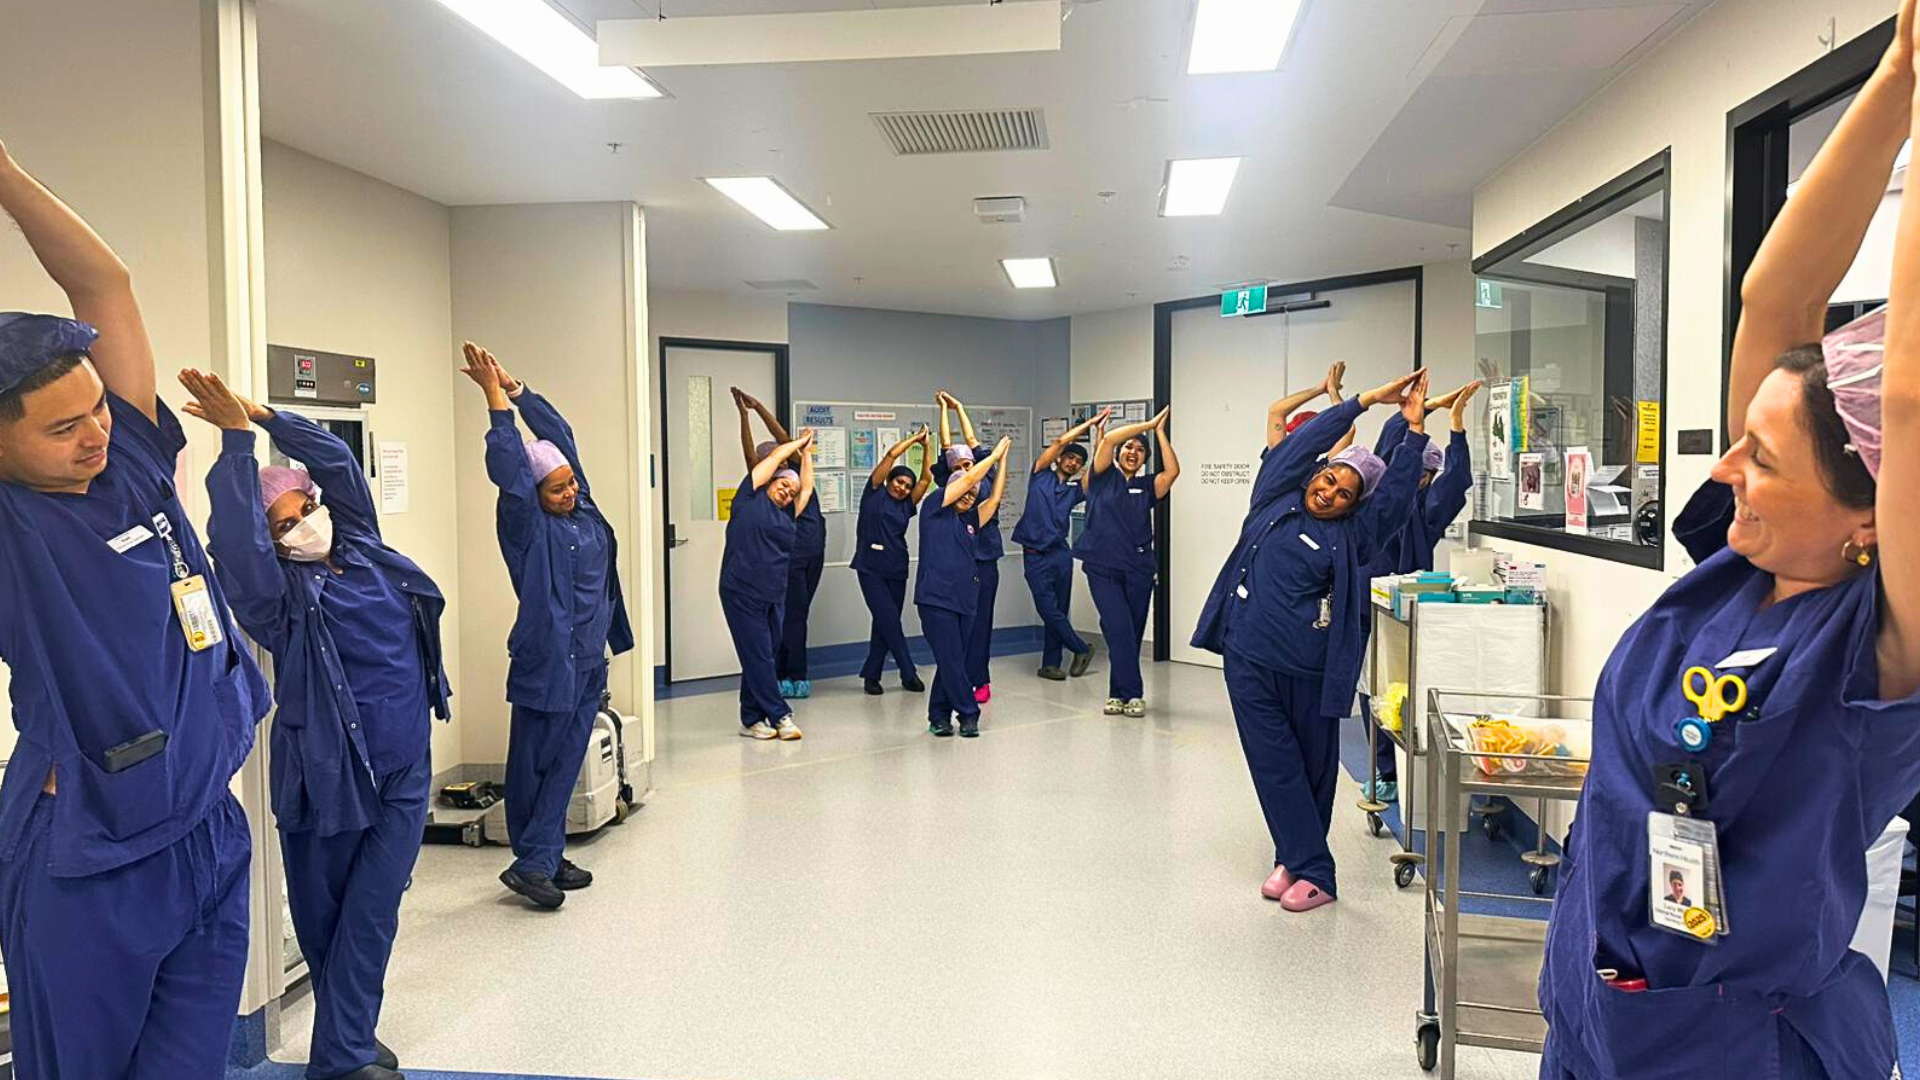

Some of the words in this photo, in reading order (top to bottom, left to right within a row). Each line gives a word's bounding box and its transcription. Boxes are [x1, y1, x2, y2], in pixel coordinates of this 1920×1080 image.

[808, 405, 831, 414] AUDIT
[805, 416, 834, 424] RESULTS
[1652, 847, 1679, 859] Northern
[1679, 855, 1701, 865] Health
[1687, 912, 1707, 930] 2025
